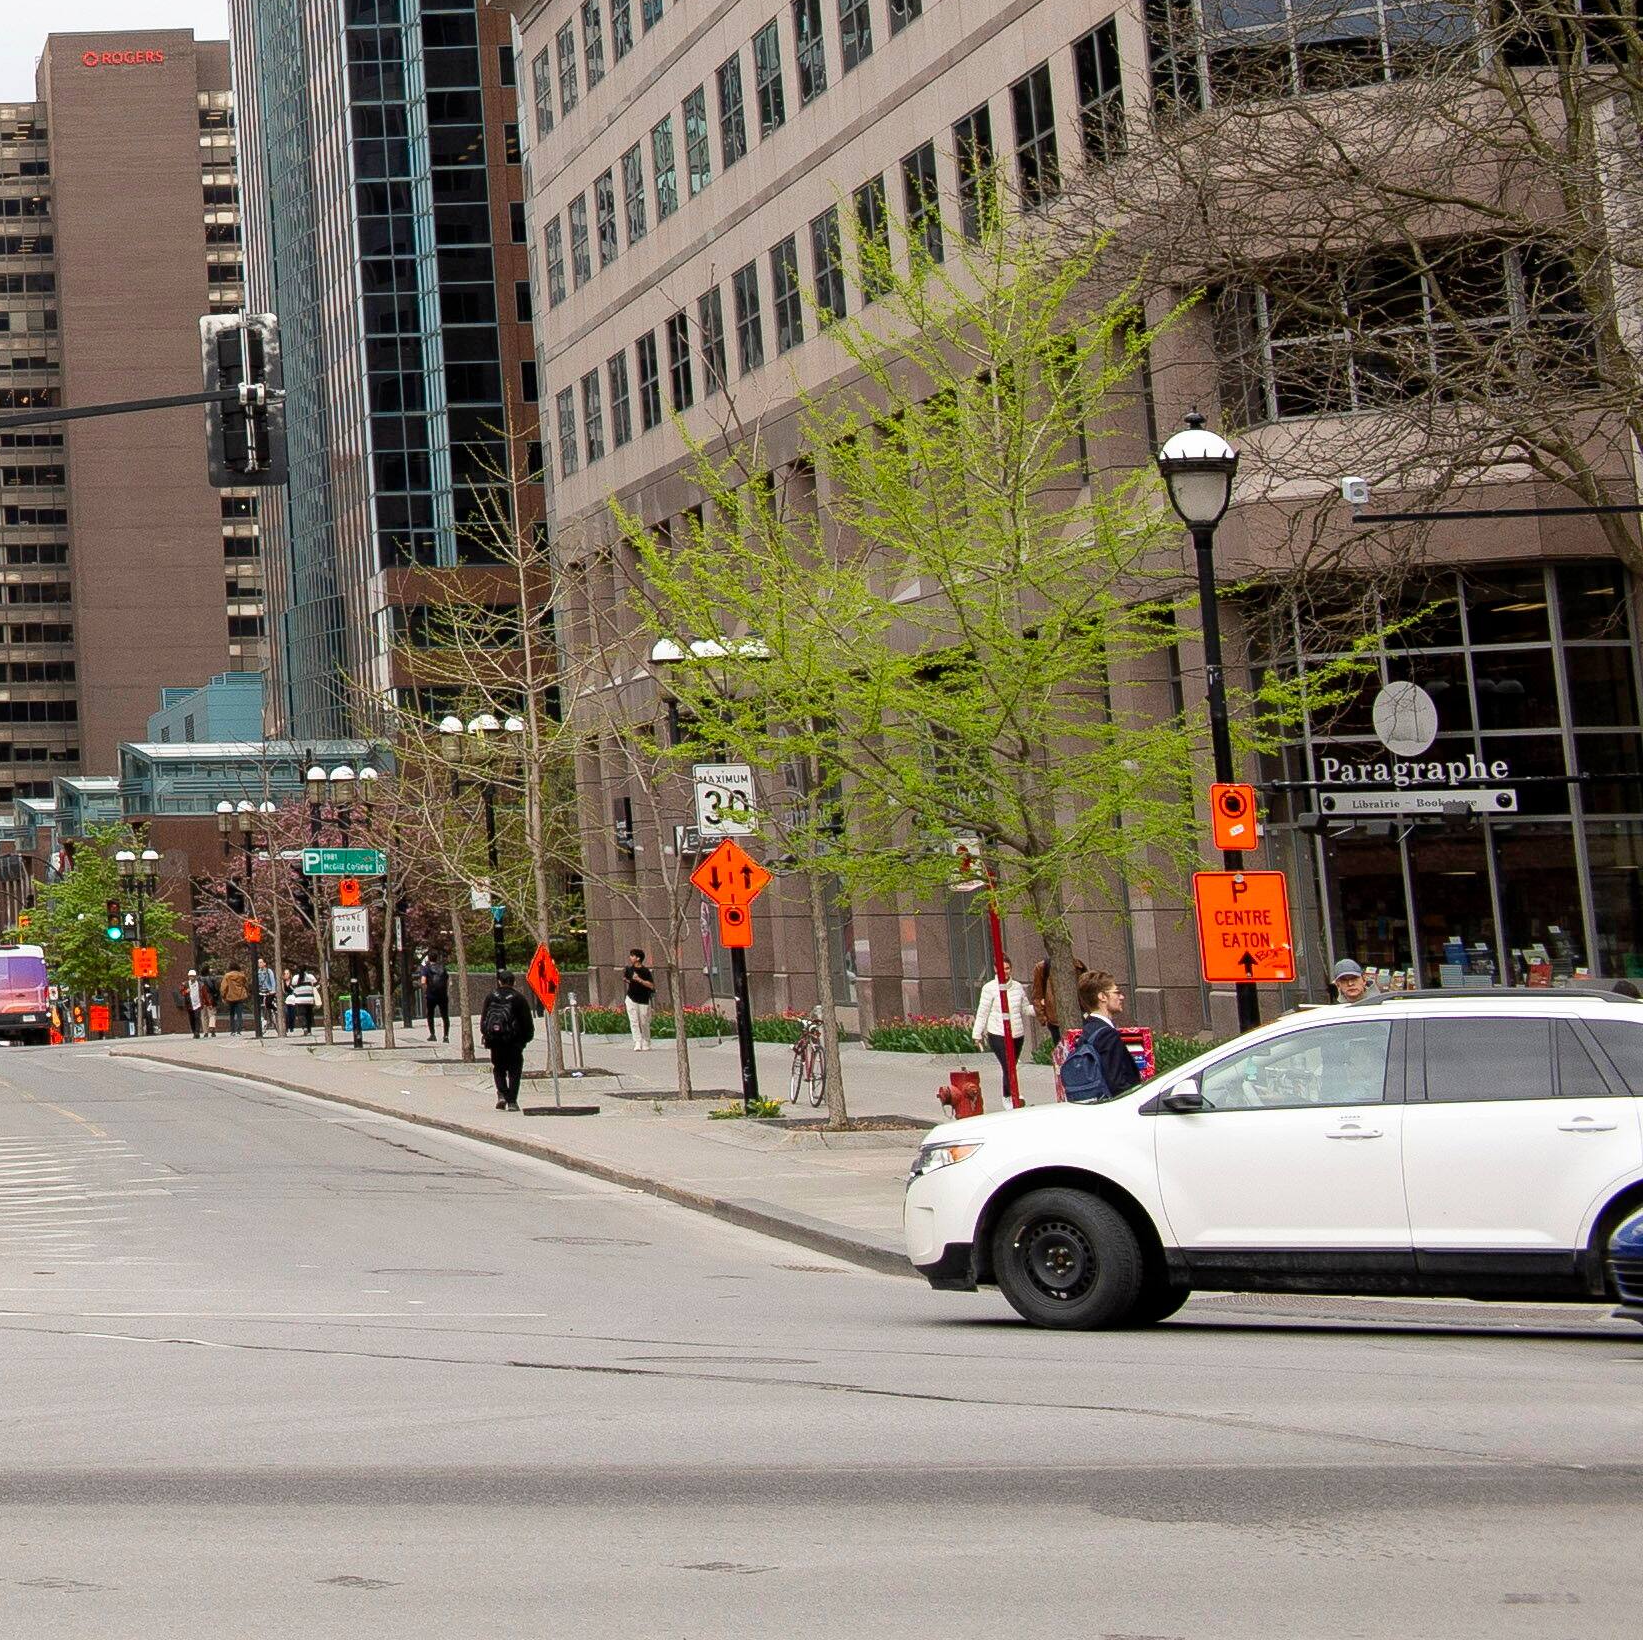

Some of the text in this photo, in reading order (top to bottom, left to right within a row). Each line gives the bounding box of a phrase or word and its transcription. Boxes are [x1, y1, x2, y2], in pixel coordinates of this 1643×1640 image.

[101, 50, 164, 65] ROGERS
[1320, 754, 1509, 787] Paragraphe
[698, 774, 749, 784] MAXIMUM
[704, 789, 749, 825] 30
[1352, 800, 1400, 809] Librairie
[304, 852, 320, 871] P
[1231, 880, 1247, 904] P
[1215, 910, 1272, 926] CENTRE
[1222, 932, 1270, 948] EATON
